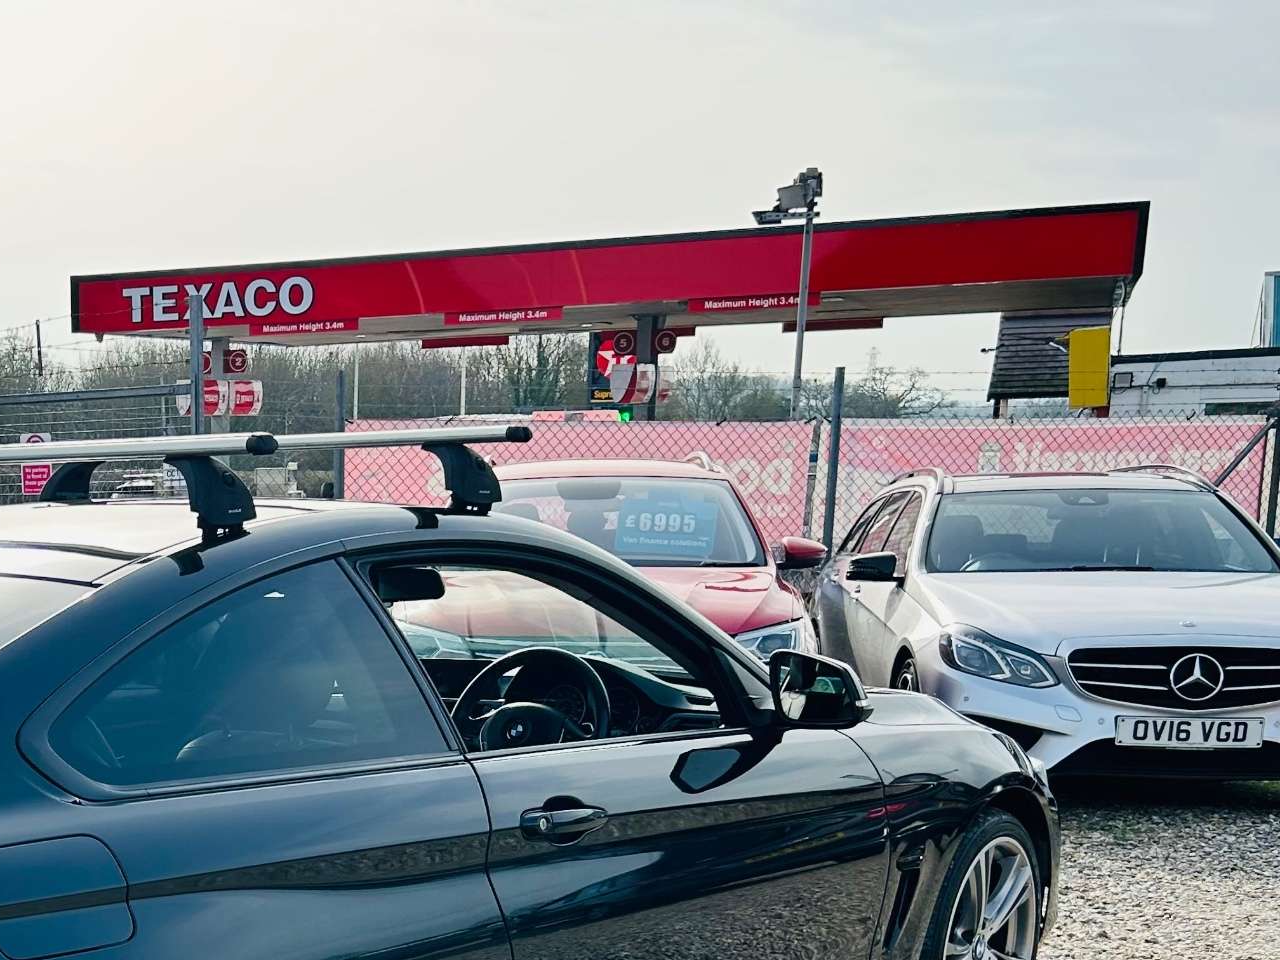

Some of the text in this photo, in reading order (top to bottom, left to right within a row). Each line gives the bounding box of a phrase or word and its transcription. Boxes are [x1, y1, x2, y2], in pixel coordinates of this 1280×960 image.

[122, 276, 313, 323] TEXACO
[704, 300, 746, 309] Maximum
[748, 298, 777, 308] Height
[459, 310, 547, 322] Maximum Height 3.4m
[263, 321, 344, 333] Maximum Height 3.4m
[1133, 720, 1248, 743] OV16 VGD
